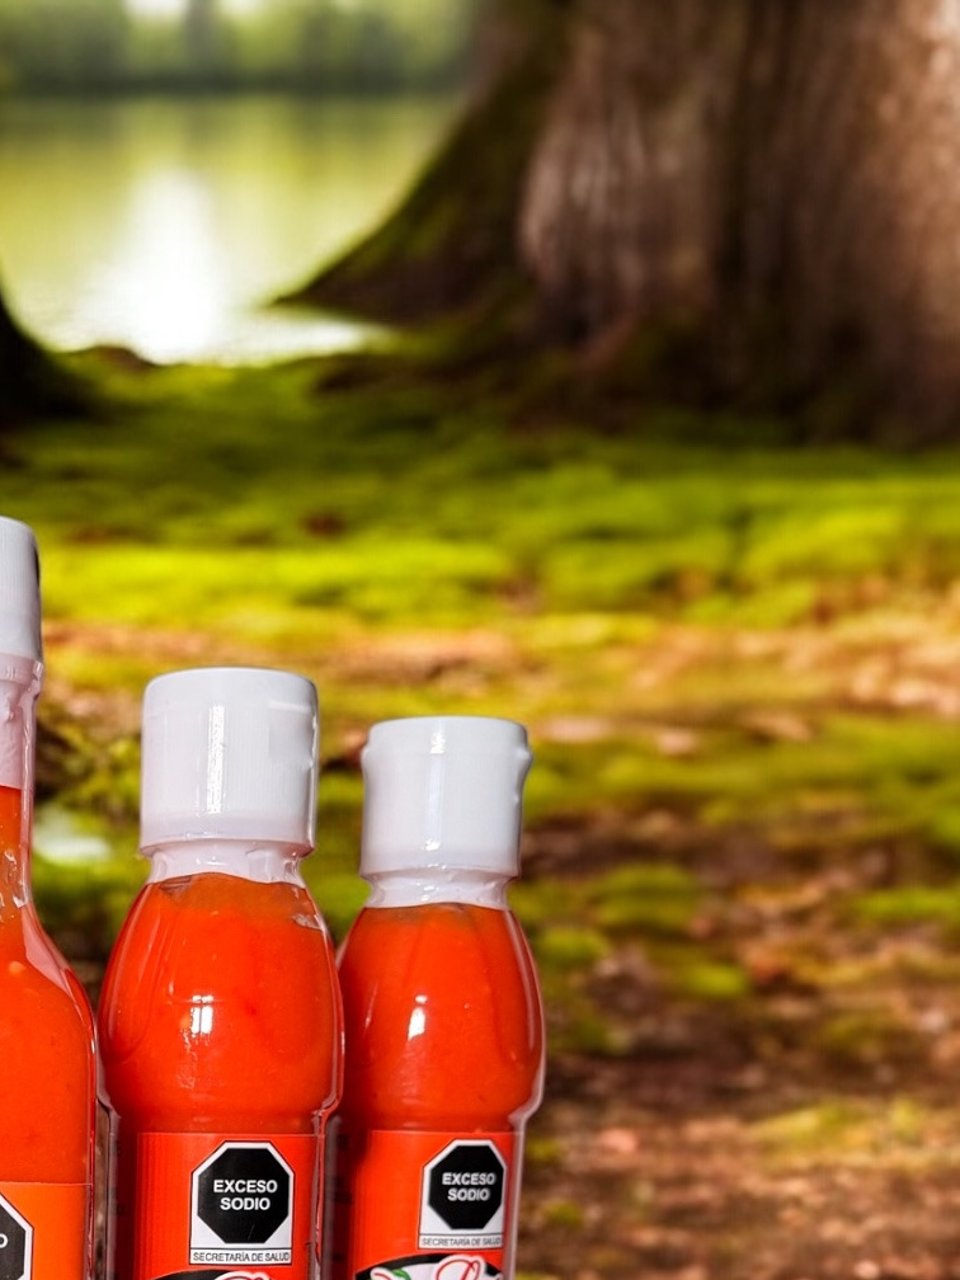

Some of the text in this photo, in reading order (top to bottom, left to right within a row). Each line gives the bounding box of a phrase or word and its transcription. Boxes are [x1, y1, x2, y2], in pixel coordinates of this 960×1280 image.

[213, 1179, 278, 1193] EXCESO
[442, 1172, 496, 1186] EXCESO
[447, 1187, 491, 1201] SODIO
[220, 1197, 271, 1211] SODIO
[193, 1251, 289, 1262] SECRETARÍA DE SALUD
